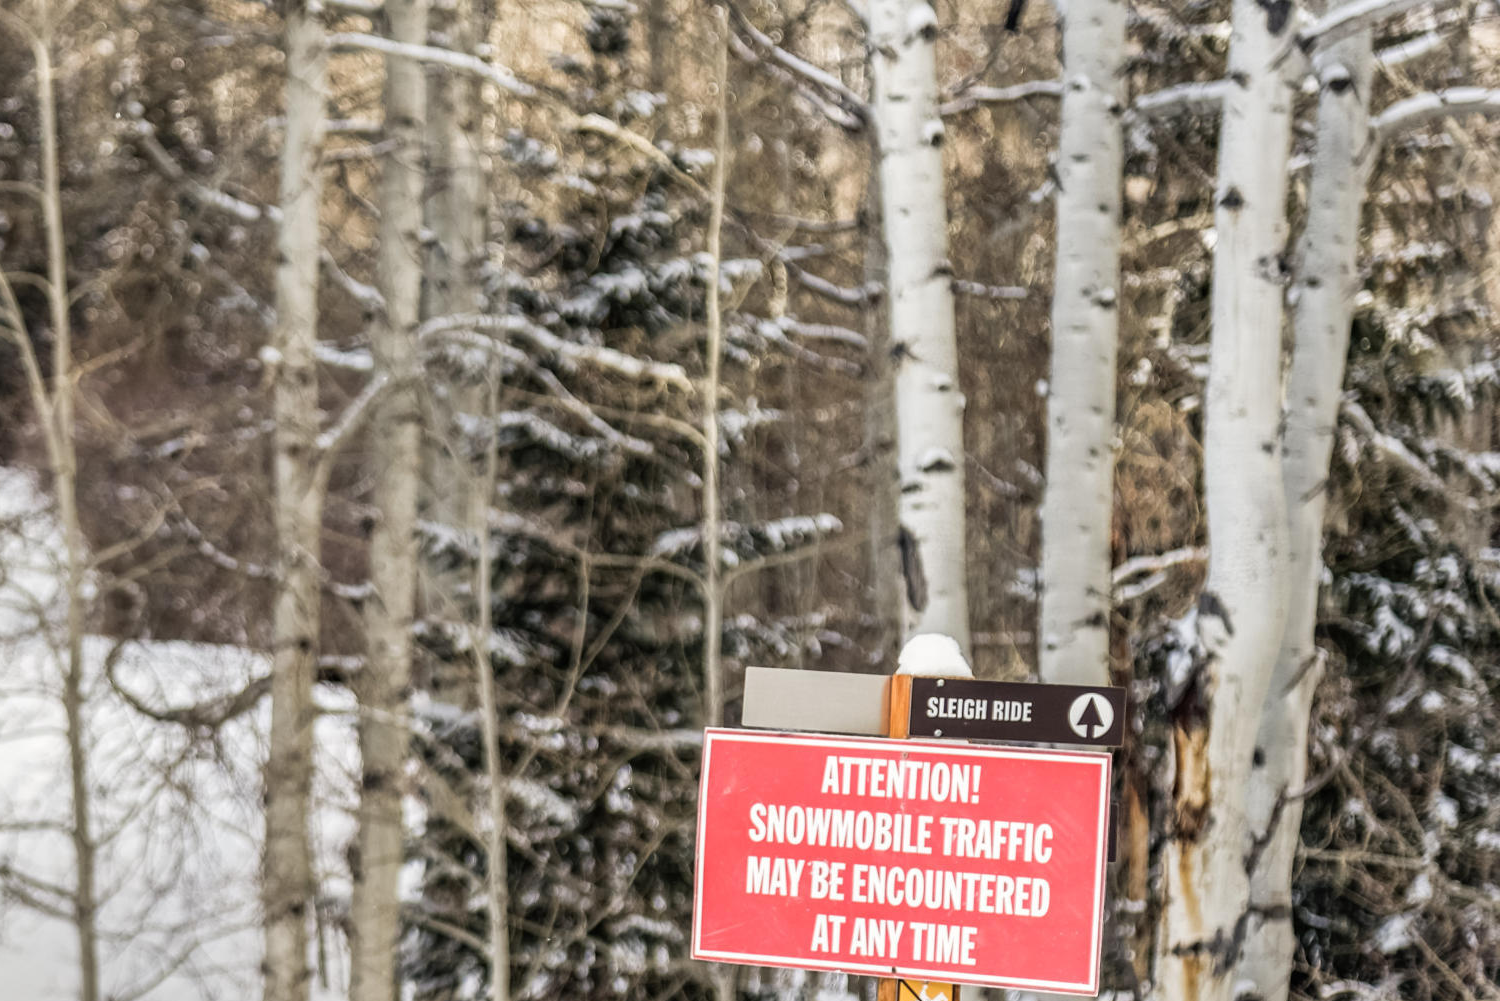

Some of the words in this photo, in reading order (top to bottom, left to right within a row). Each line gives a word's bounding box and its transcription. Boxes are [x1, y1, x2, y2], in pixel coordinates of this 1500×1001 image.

[926, 696, 988, 720] SLEIGH
[991, 700, 1033, 722] RIDE
[821, 755, 982, 804] ATTENTION!
[748, 802, 933, 855] SNOWMOBILE
[939, 816, 1054, 864] TRAFFIC
[746, 855, 805, 898] MAY
[810, 860, 846, 901] BE
[851, 863, 1051, 918] ENCOUNTERED
[810, 914, 846, 954] AT
[850, 917, 904, 959] ANY
[909, 921, 978, 966] TIME
